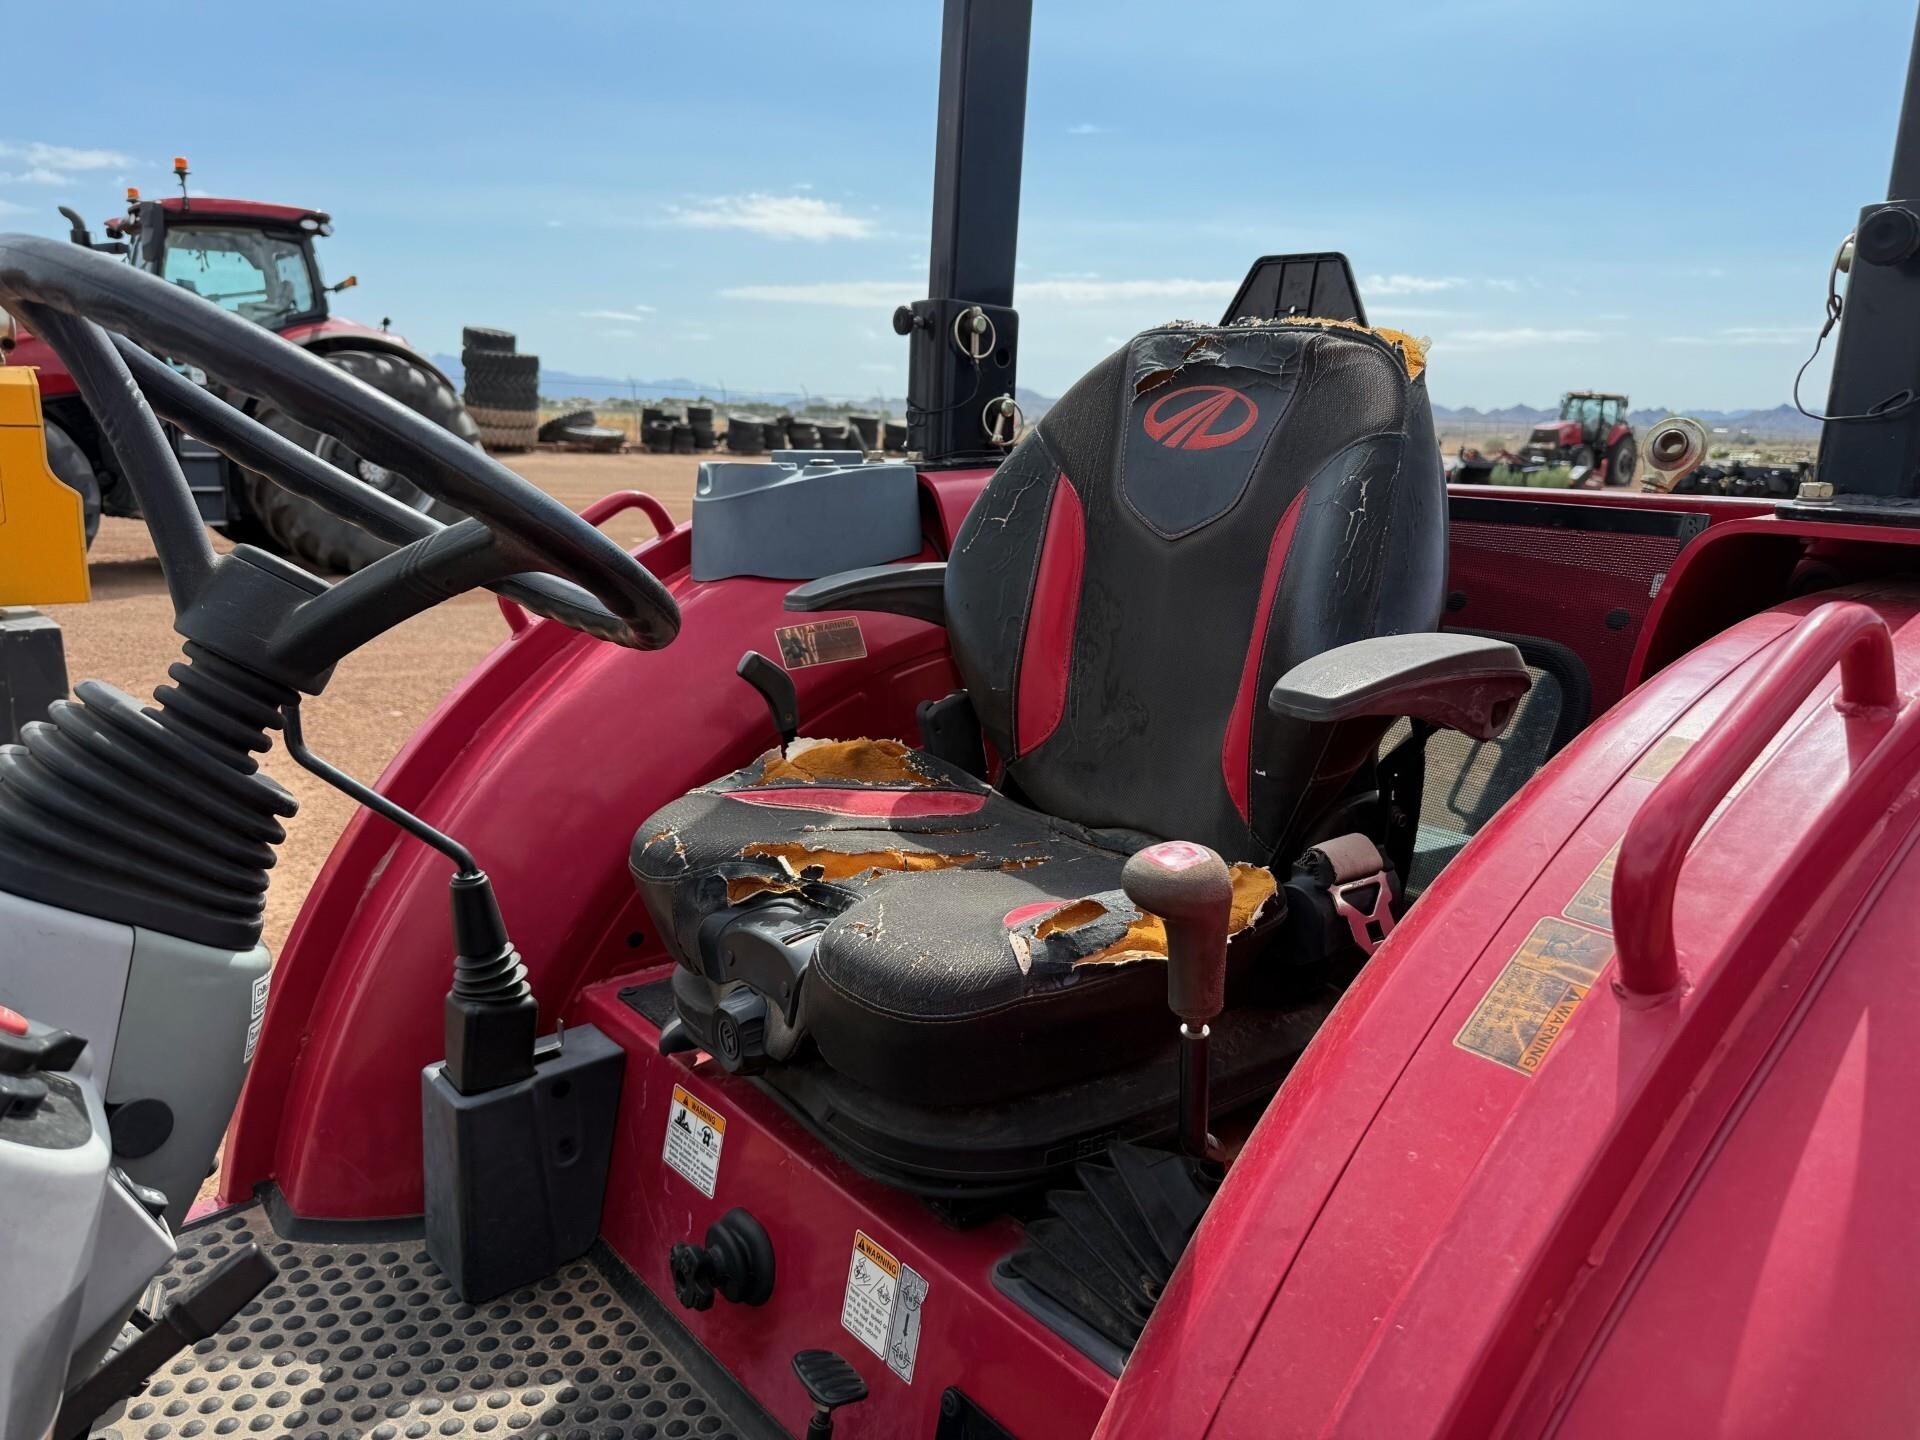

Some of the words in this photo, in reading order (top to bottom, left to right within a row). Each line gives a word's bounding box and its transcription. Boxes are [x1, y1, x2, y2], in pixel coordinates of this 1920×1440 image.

[1523, 1005, 1574, 1068] WARNING
[691, 1104, 716, 1125] WARNING
[865, 1243, 897, 1274] WARNING
